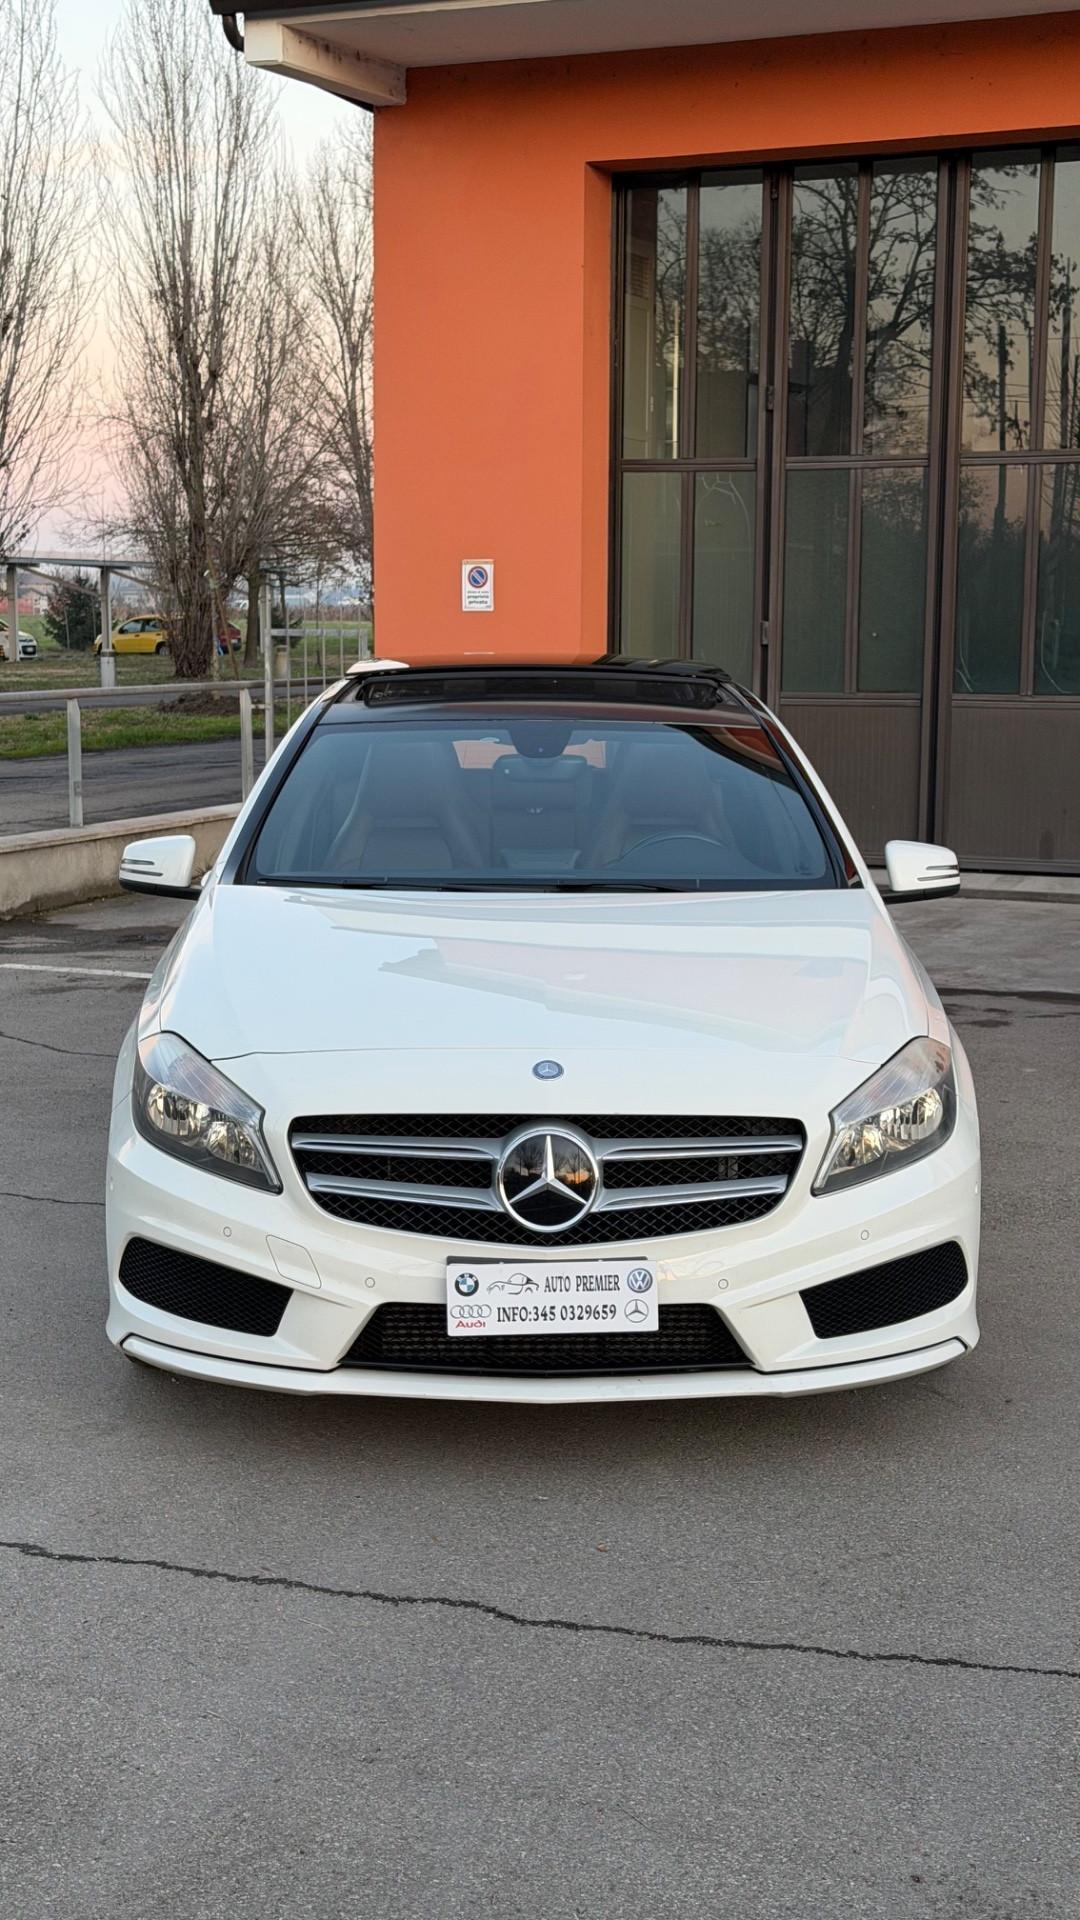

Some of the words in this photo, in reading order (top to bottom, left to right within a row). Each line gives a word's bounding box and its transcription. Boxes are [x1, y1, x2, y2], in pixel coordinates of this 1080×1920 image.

[544, 1275, 571, 1292] AUTO
[575, 1274, 620, 1292] PREMIER
[560, 1304, 617, 1321] 0329659
[455, 1319, 486, 1328] Audi
